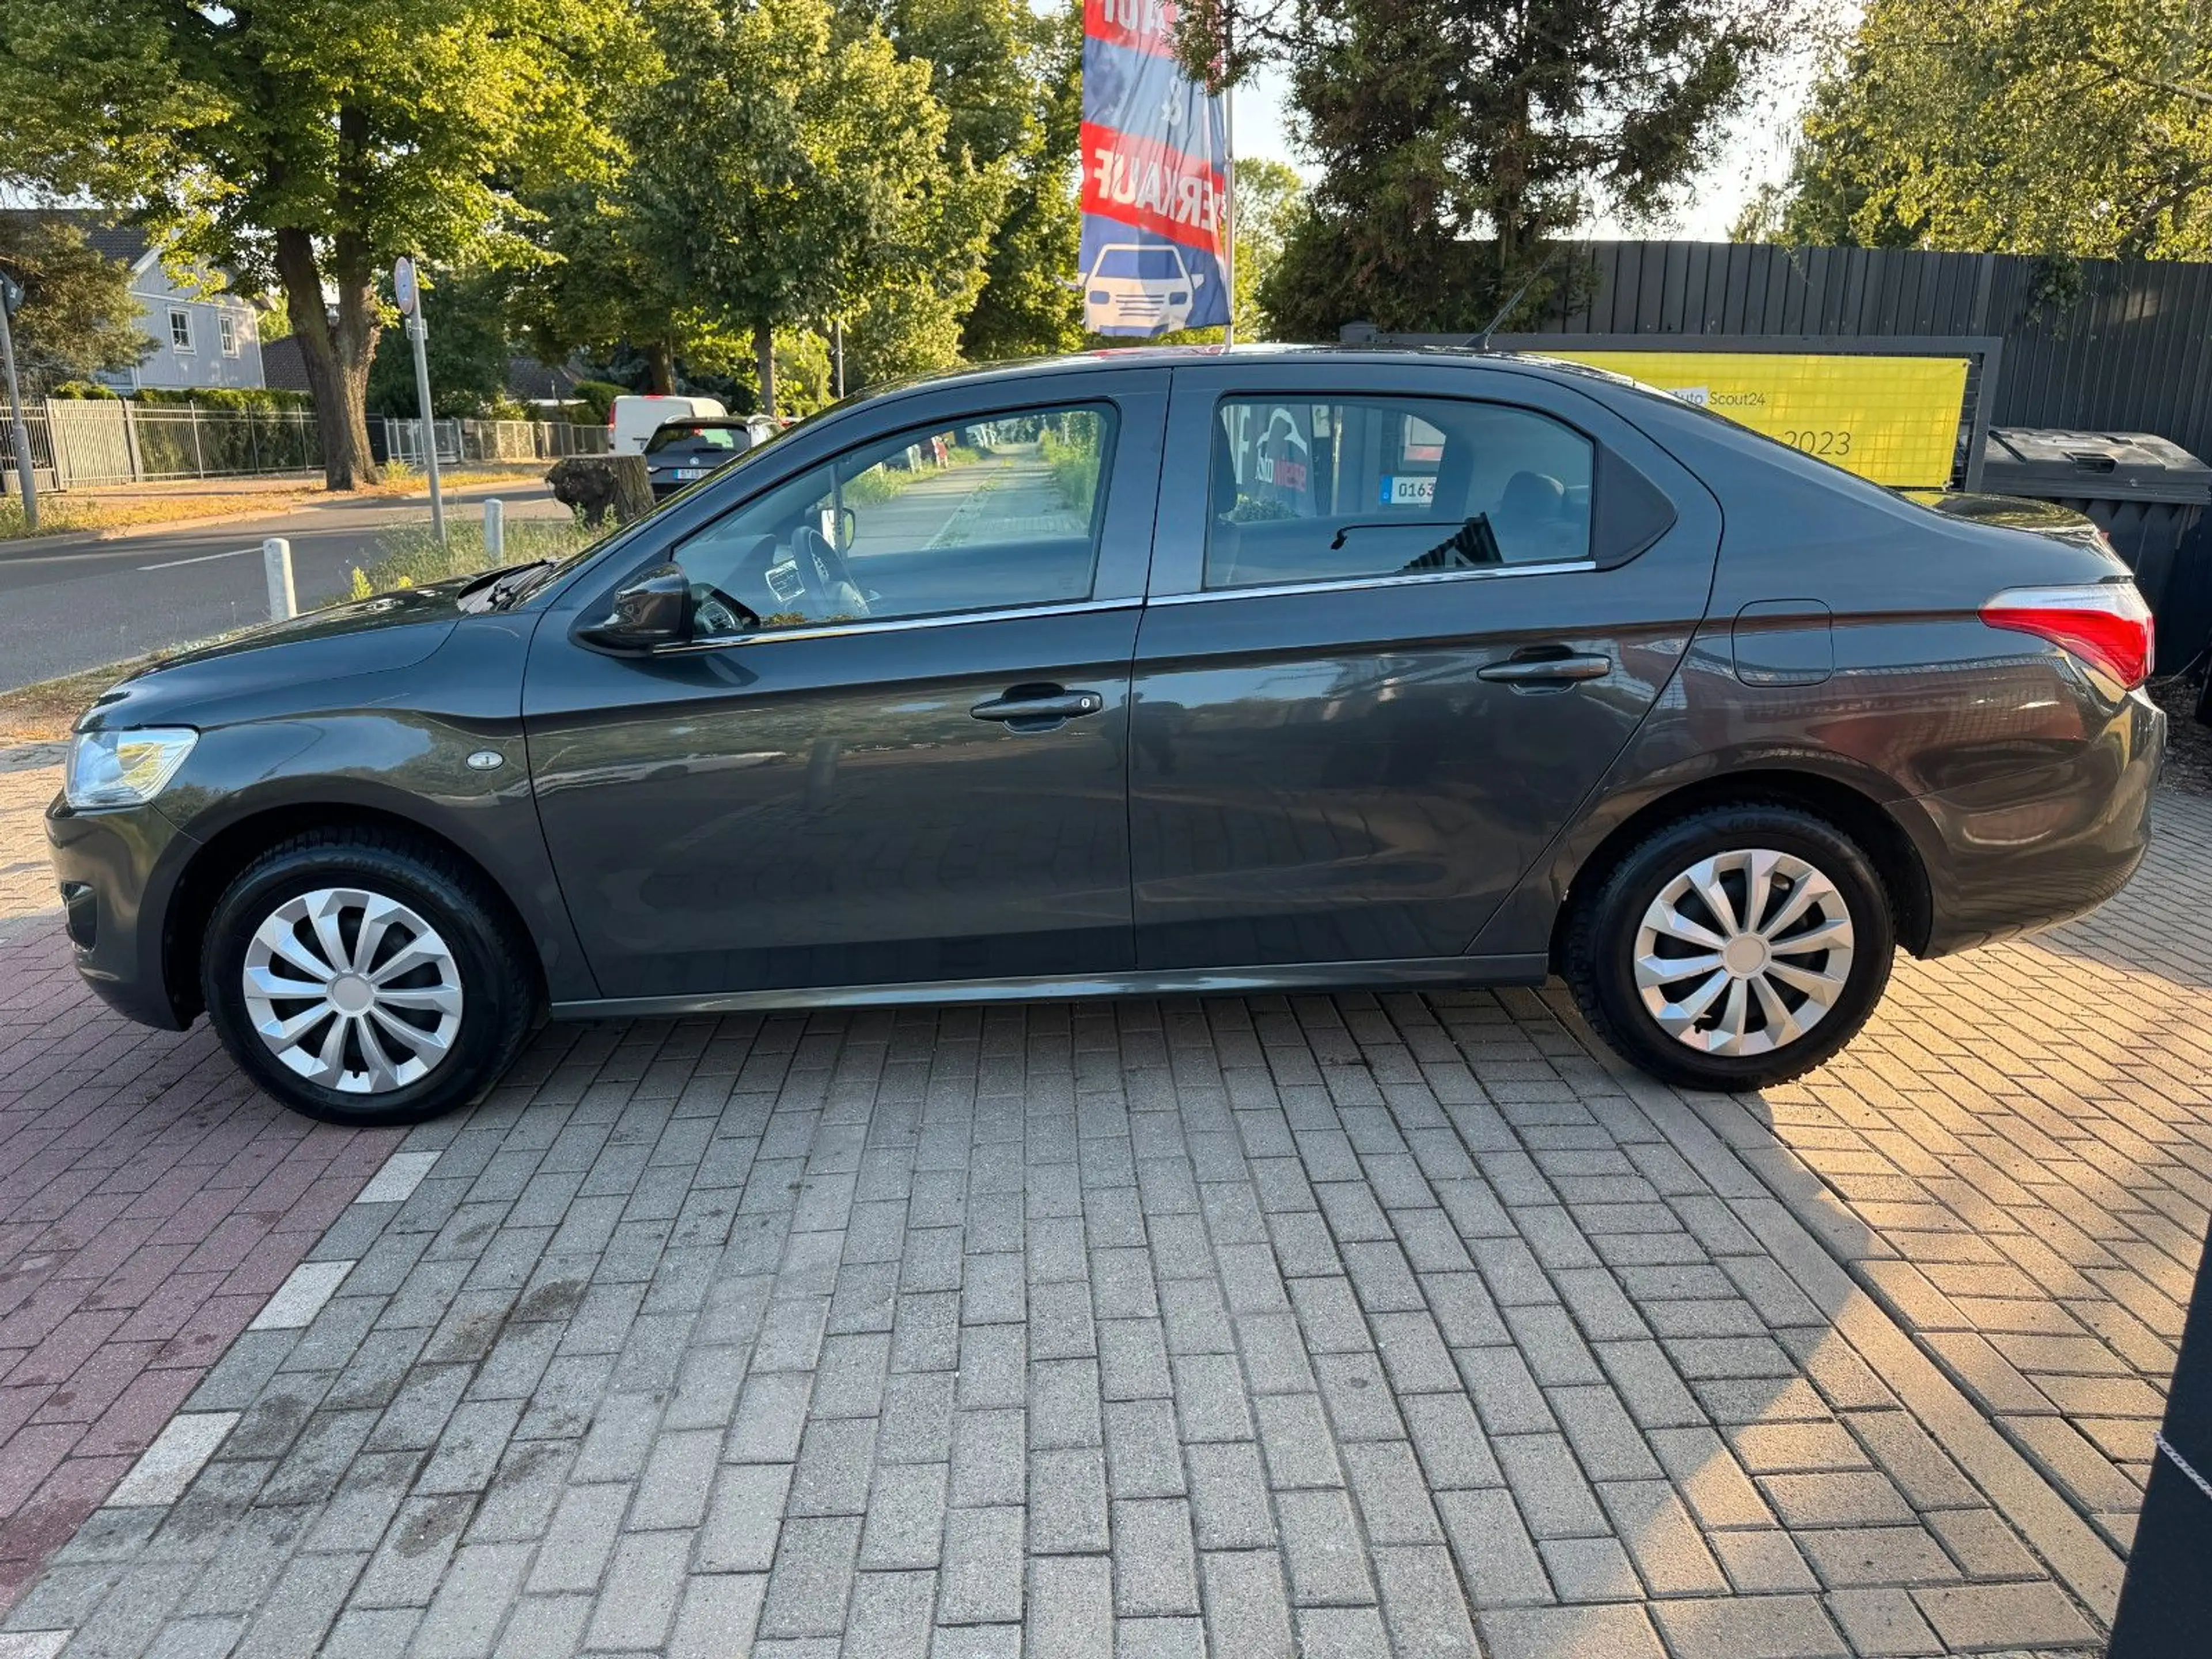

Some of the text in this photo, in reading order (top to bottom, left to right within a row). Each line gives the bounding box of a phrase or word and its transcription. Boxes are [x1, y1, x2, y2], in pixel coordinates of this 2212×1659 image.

[1709, 391, 1766, 406] Scout24
[1785, 431, 1851, 456] 2023
[1399, 483, 1434, 497] 0163
